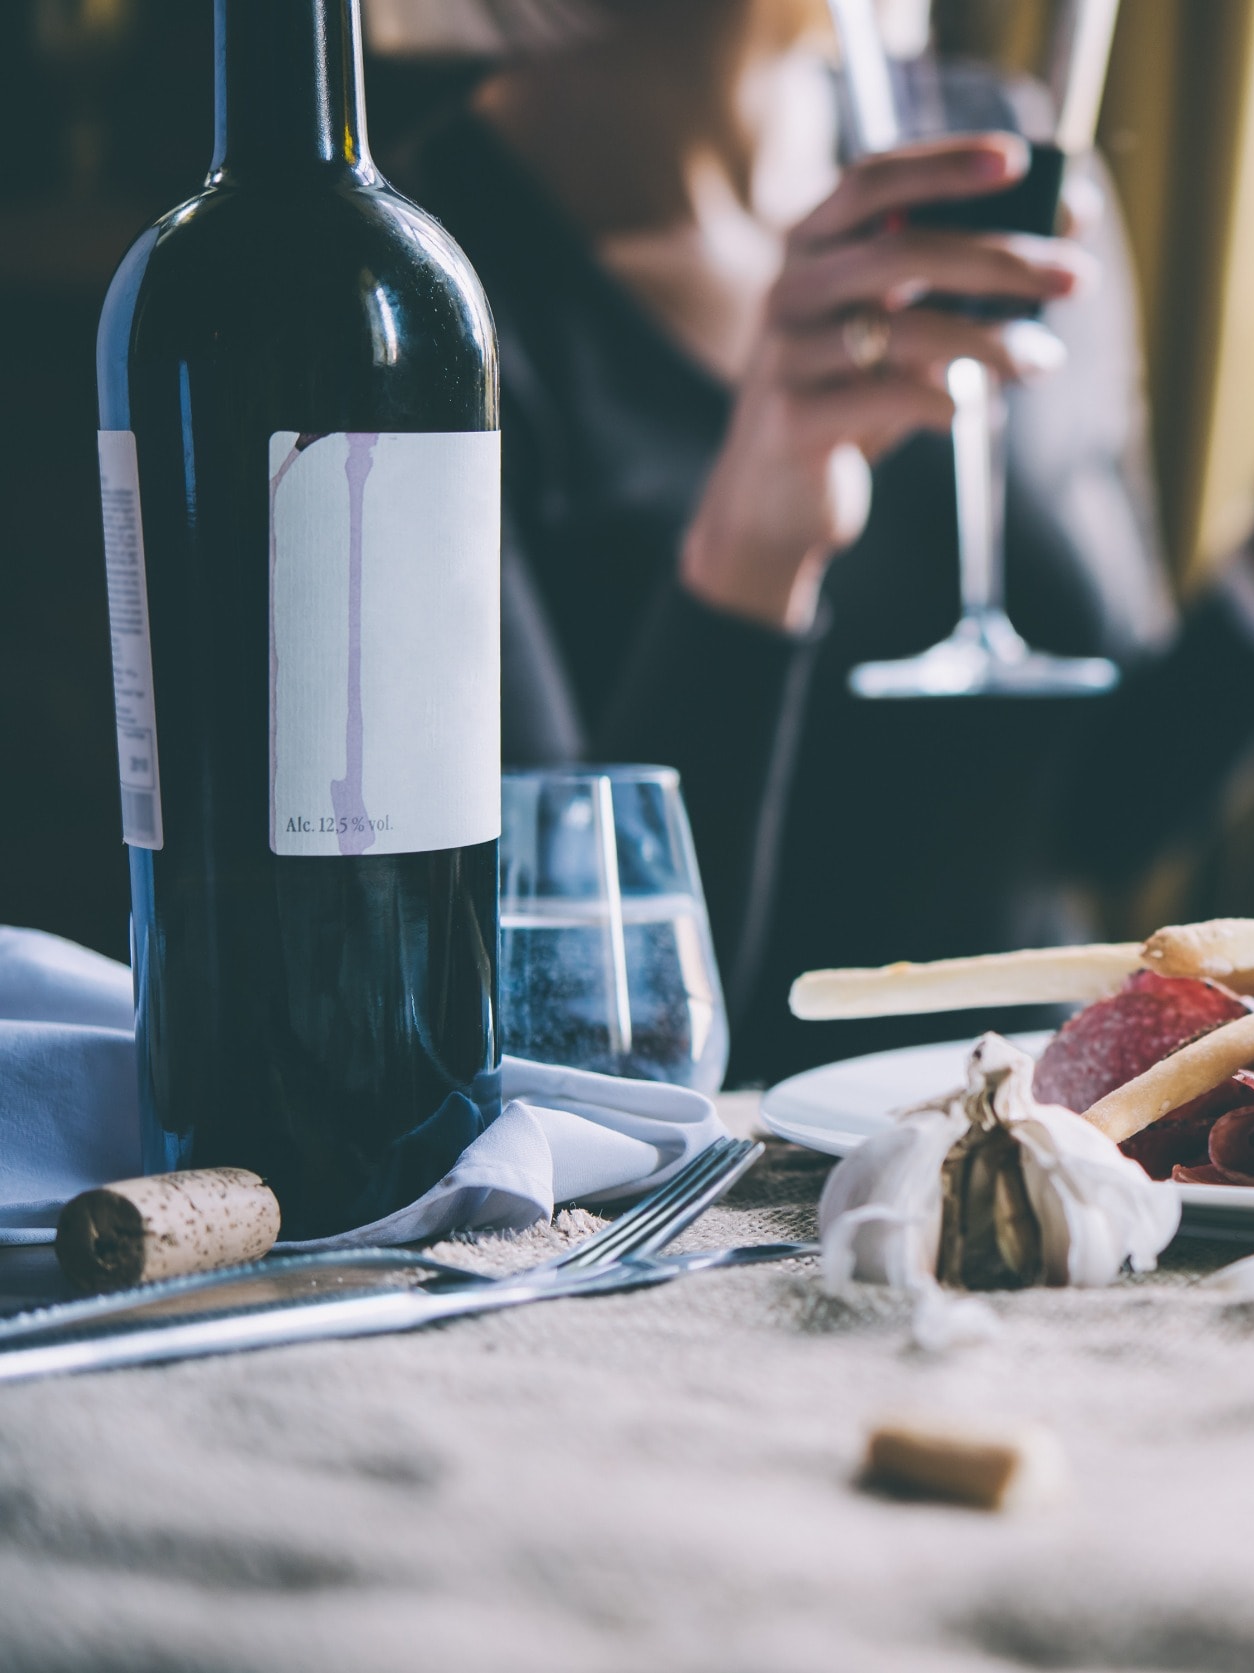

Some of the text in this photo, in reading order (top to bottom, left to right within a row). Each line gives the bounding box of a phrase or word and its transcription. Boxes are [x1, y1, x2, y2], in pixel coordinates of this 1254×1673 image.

[286, 814, 394, 834] Alc. 12,5 % vol.
